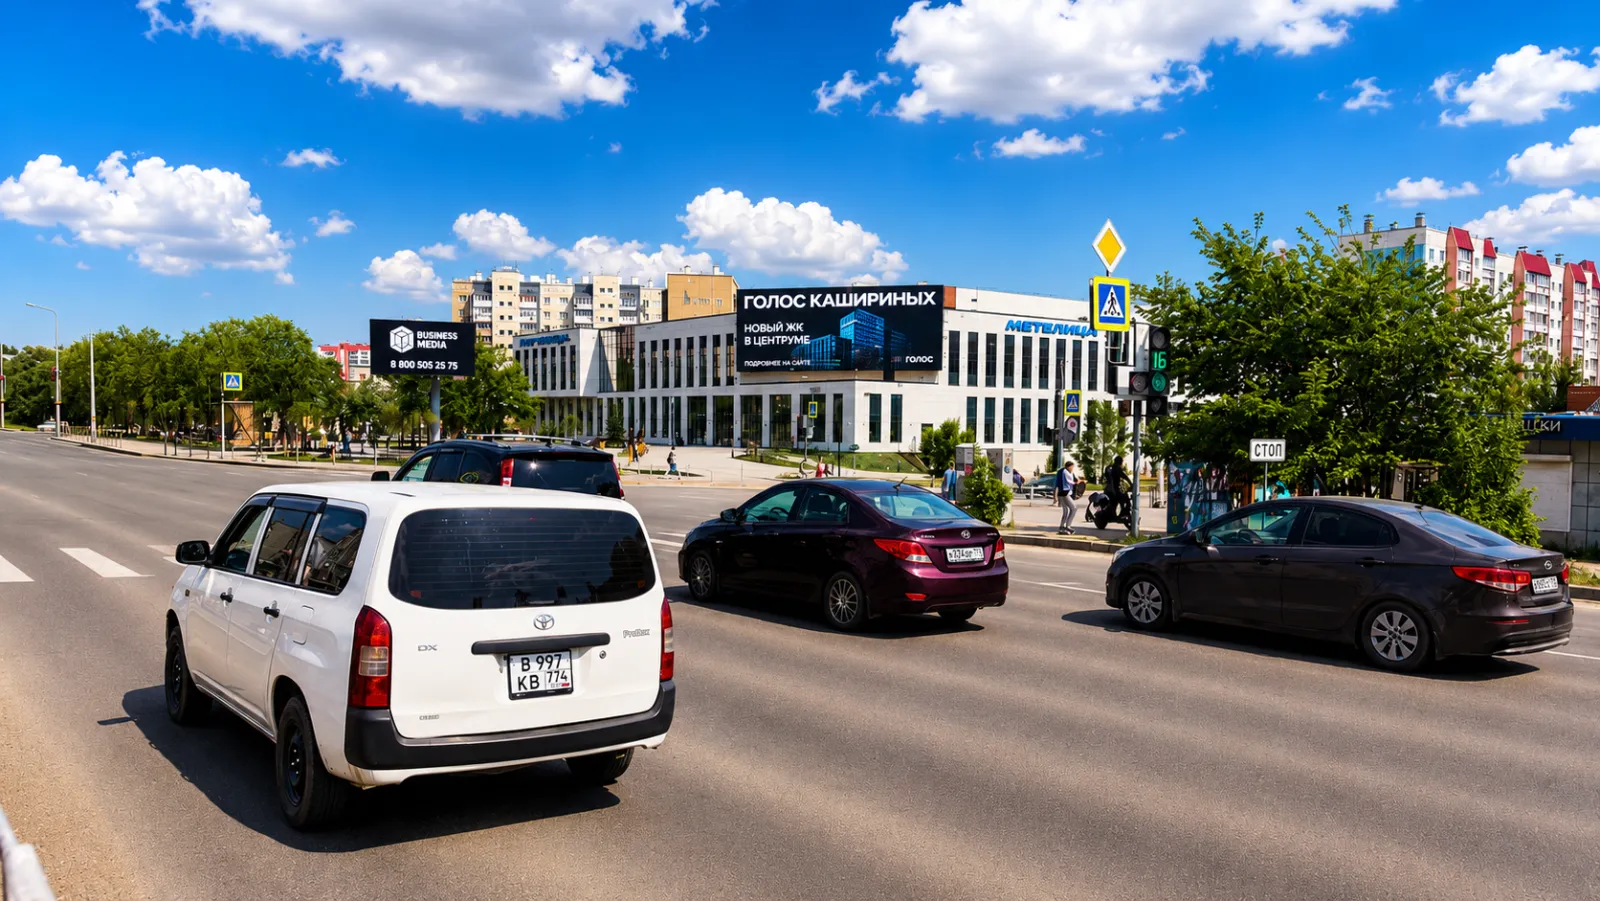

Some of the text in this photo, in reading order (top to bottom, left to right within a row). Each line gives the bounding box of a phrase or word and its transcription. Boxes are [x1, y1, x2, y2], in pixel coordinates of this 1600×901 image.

[744, 291, 936, 309] ГОЛОС КАШИРИНЫХ
[744, 321, 804, 333] НОВЫЙ ЖК
[1005, 319, 1098, 338] МЕТЕЛИЦА
[417, 331, 458, 340] BUSINESS
[744, 335, 810, 347] В ЦЕНТРУМЕ
[417, 340, 447, 349] MEDIA
[390, 360, 458, 370] 8 800 505 25 75
[905, 355, 934, 364] ГОЛОС
[1153, 351, 1167, 369] 16
[1254, 443, 1282, 457] СТОП
[521, 654, 562, 672] В 997
[517, 670, 568, 691] КВ 774
